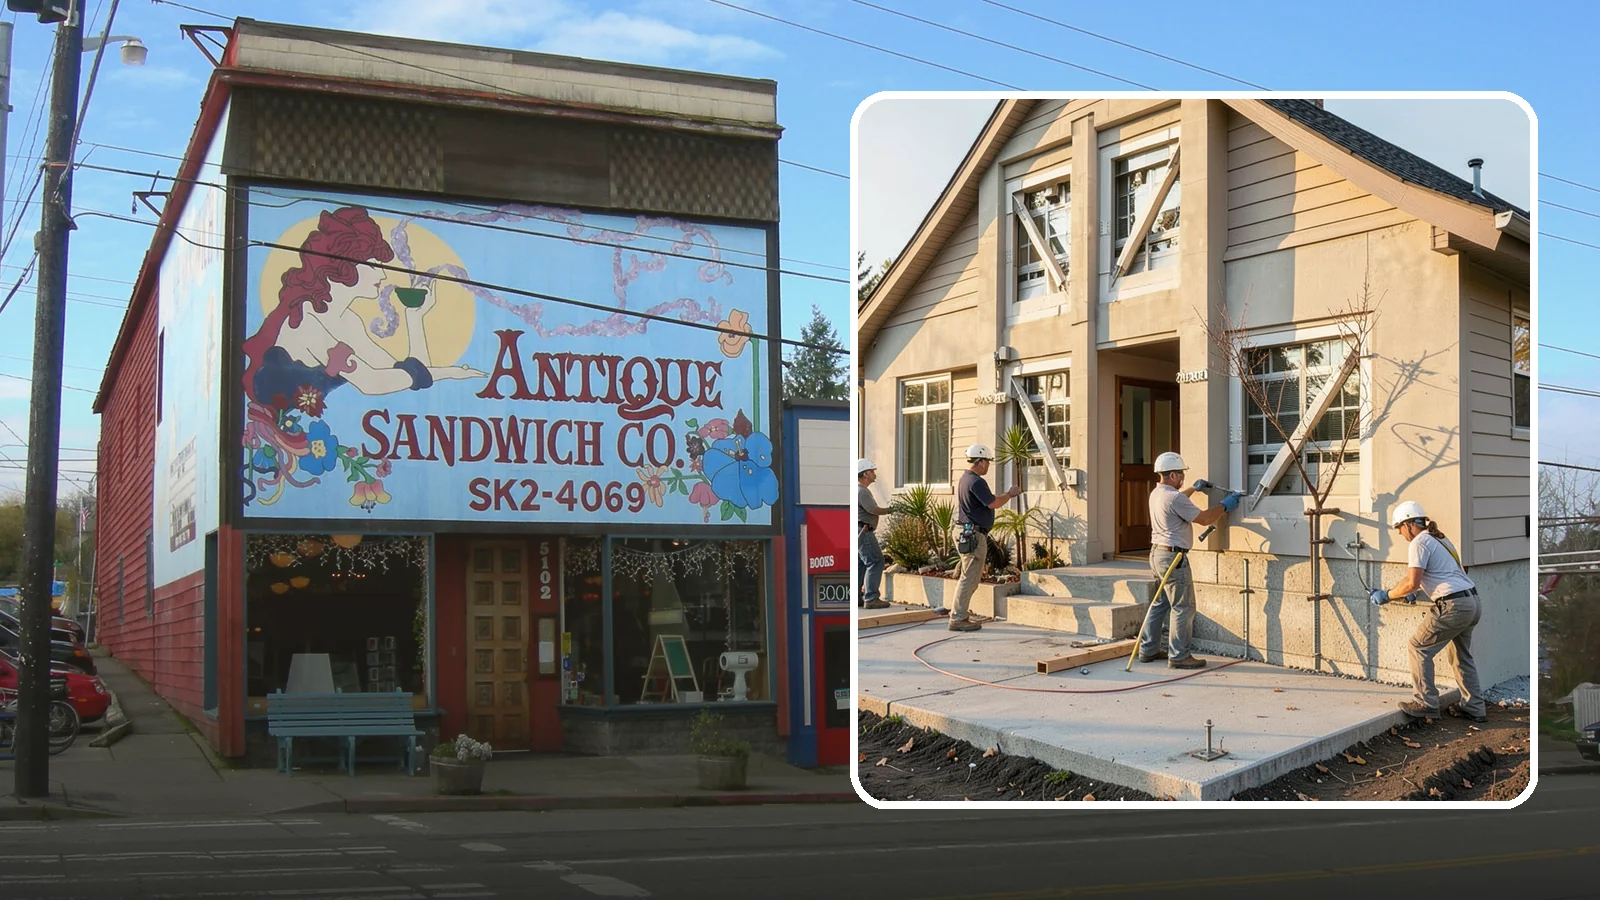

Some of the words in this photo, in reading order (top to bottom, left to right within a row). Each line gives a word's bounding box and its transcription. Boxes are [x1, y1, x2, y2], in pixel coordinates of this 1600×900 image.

[476, 330, 723, 420] ANTIQUE
[361, 409, 604, 467] SANDWICH
[617, 422, 684, 469] CO.
[468, 477, 645, 513] SK2-4069
[540, 542, 552, 599] 5102
[809, 555, 835, 569] BOOKS
